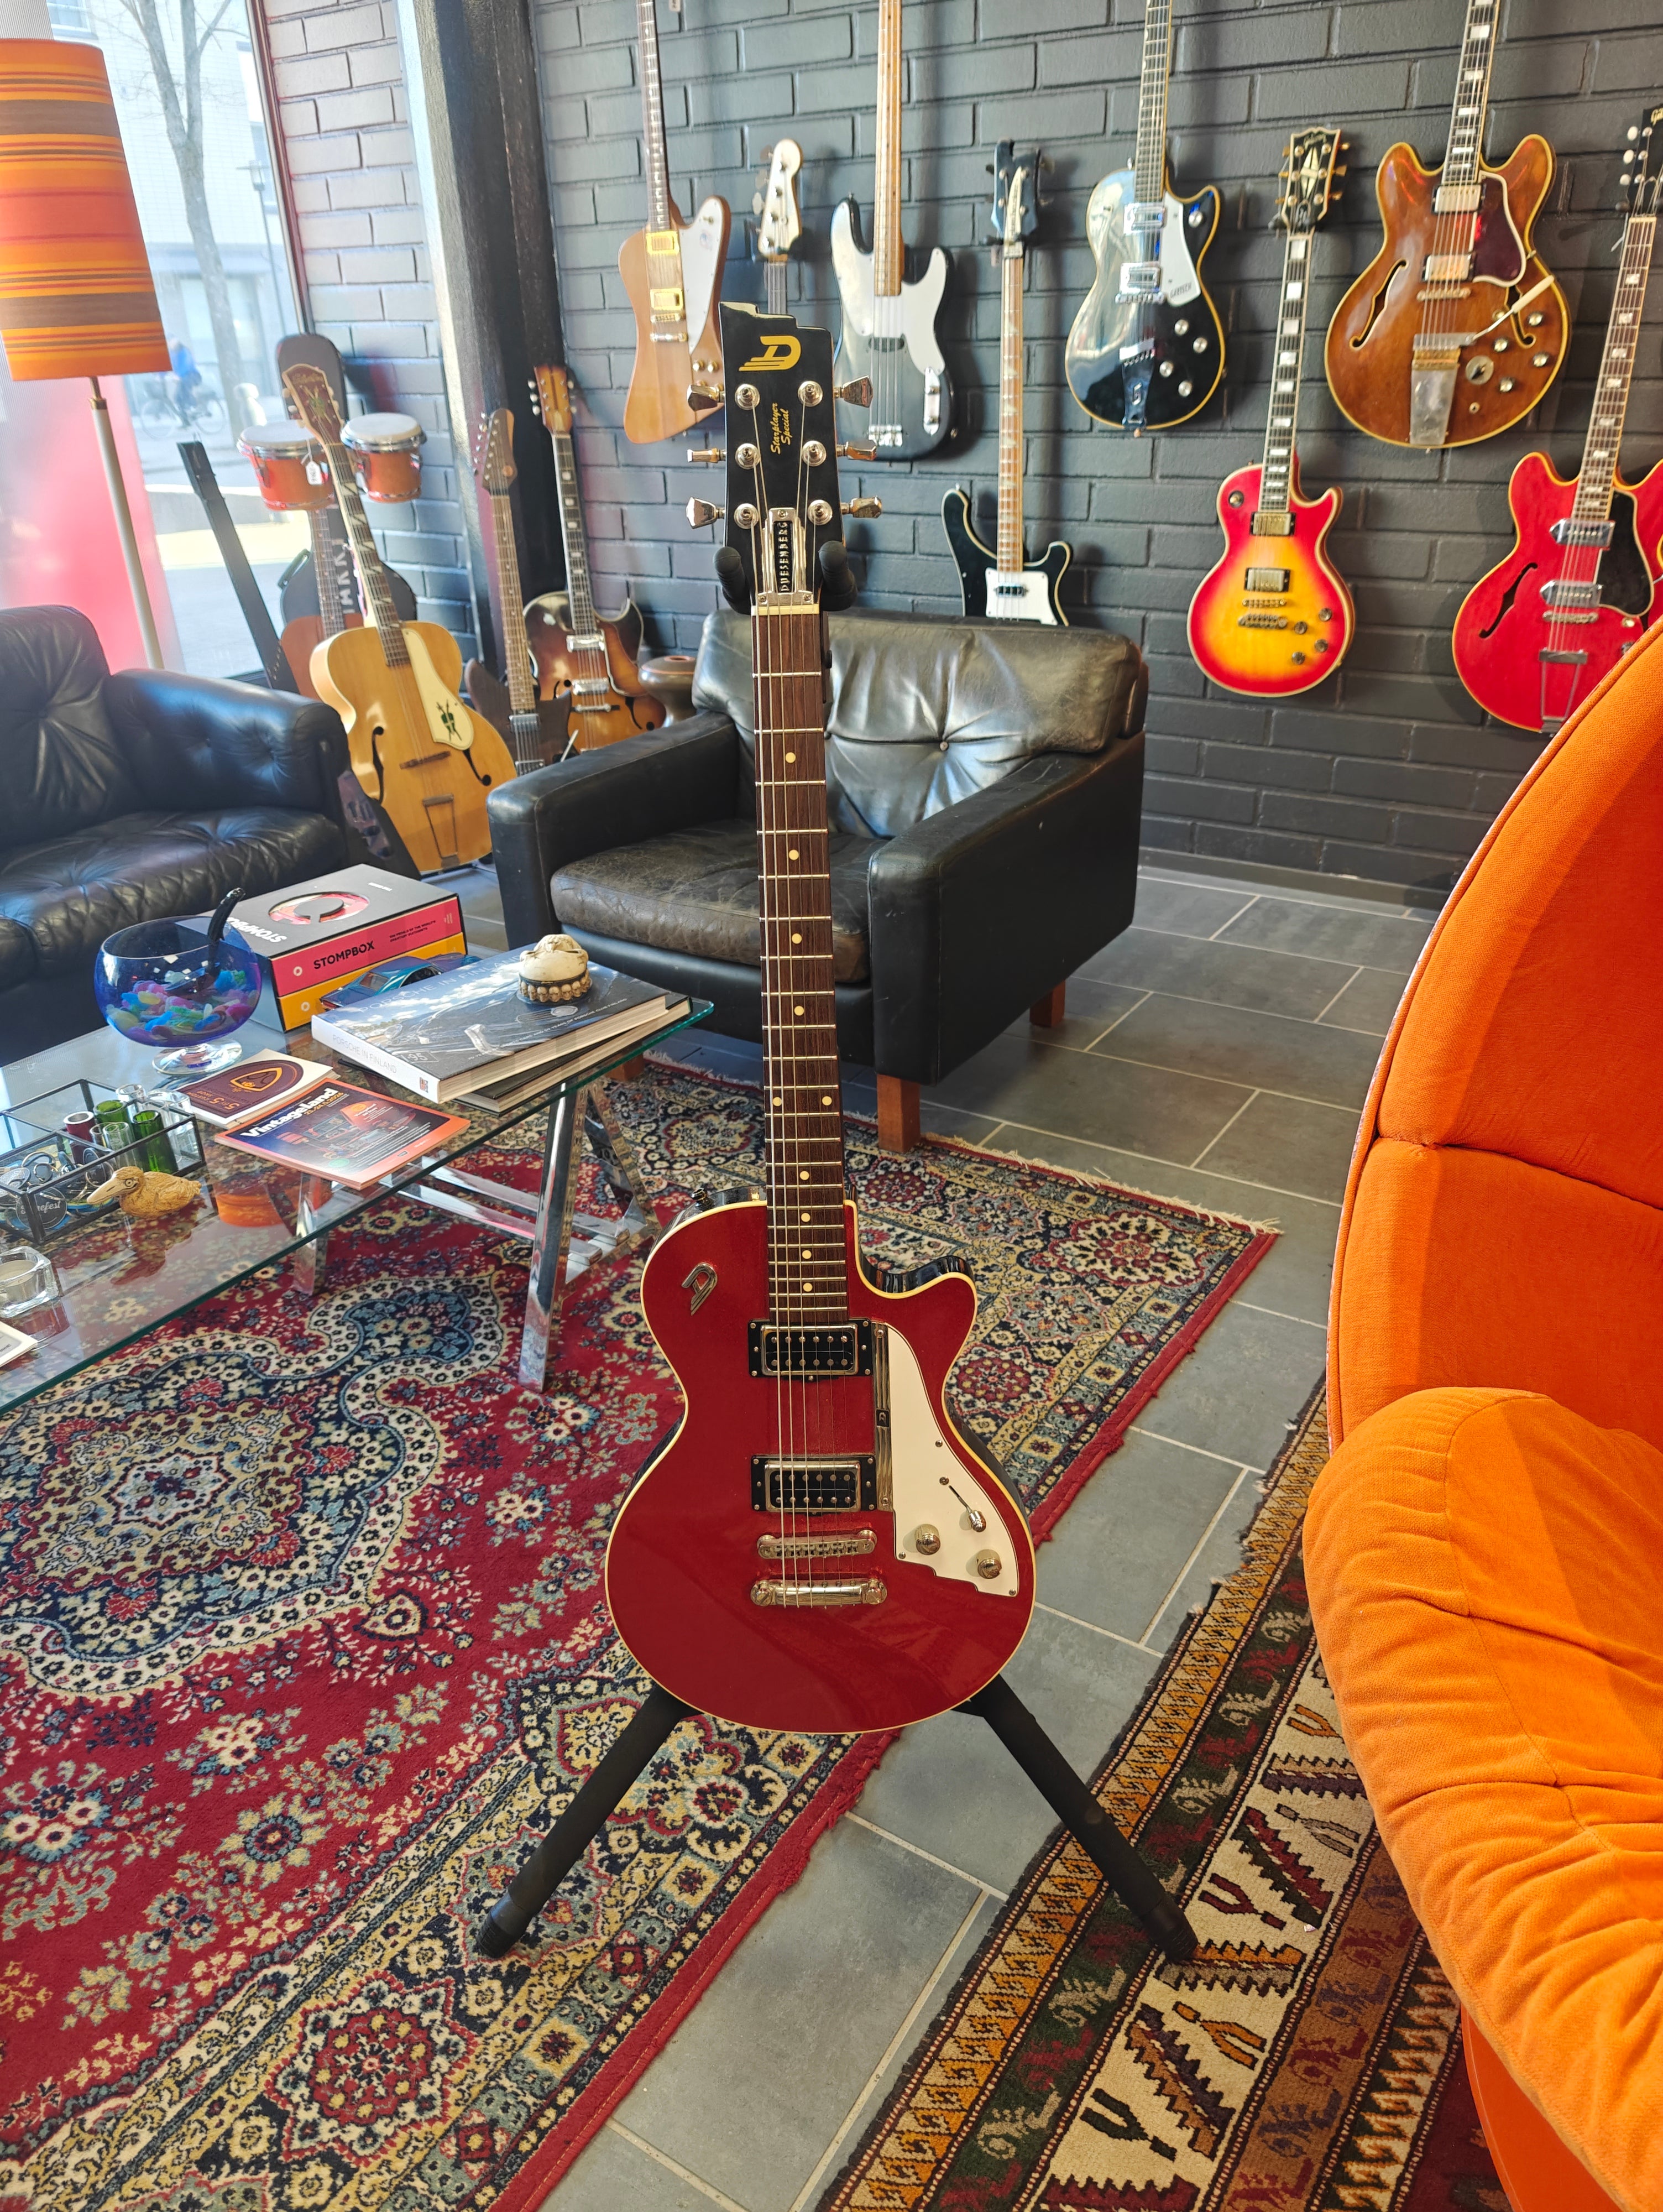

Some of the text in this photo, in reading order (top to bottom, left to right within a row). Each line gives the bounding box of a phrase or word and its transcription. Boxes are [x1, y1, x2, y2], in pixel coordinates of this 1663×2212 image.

[770, 403, 782, 455] Starplayer
[780, 408, 793, 445] Special
[777, 521, 791, 592] DUESENBERG
[313, 941, 375, 970] STOMPBOX
[358, 985, 436, 1013] PORSCHE
[440, 977, 457, 987] IN
[333, 1034, 397, 1074] PORSCHE IN FINLAND
[240, 1088, 339, 1138] Vintageland
